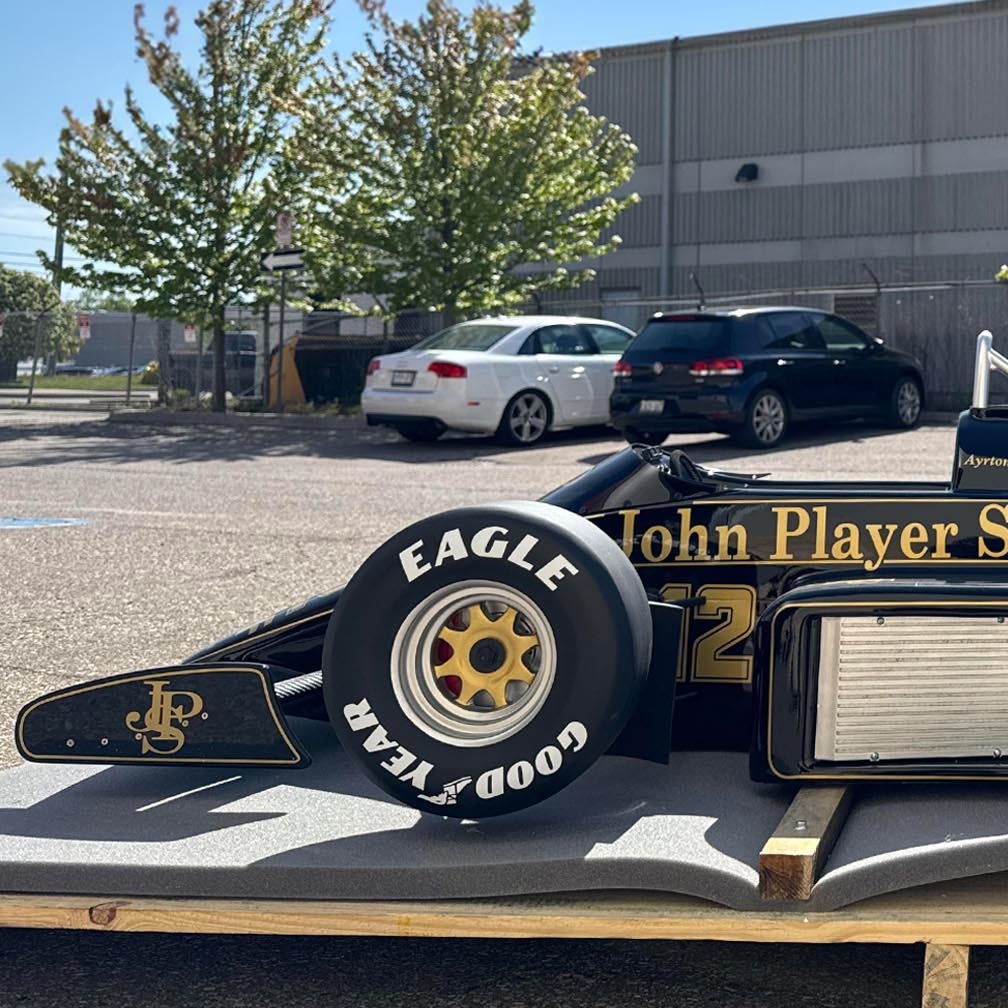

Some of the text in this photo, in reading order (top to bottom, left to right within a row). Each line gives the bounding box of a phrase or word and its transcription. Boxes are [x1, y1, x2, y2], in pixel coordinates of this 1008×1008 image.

[399, 526, 580, 591] EAGLE
[618, 506, 750, 563] John
[769, 505, 959, 572] Player
[343, 698, 589, 800] GOOD YEAR
